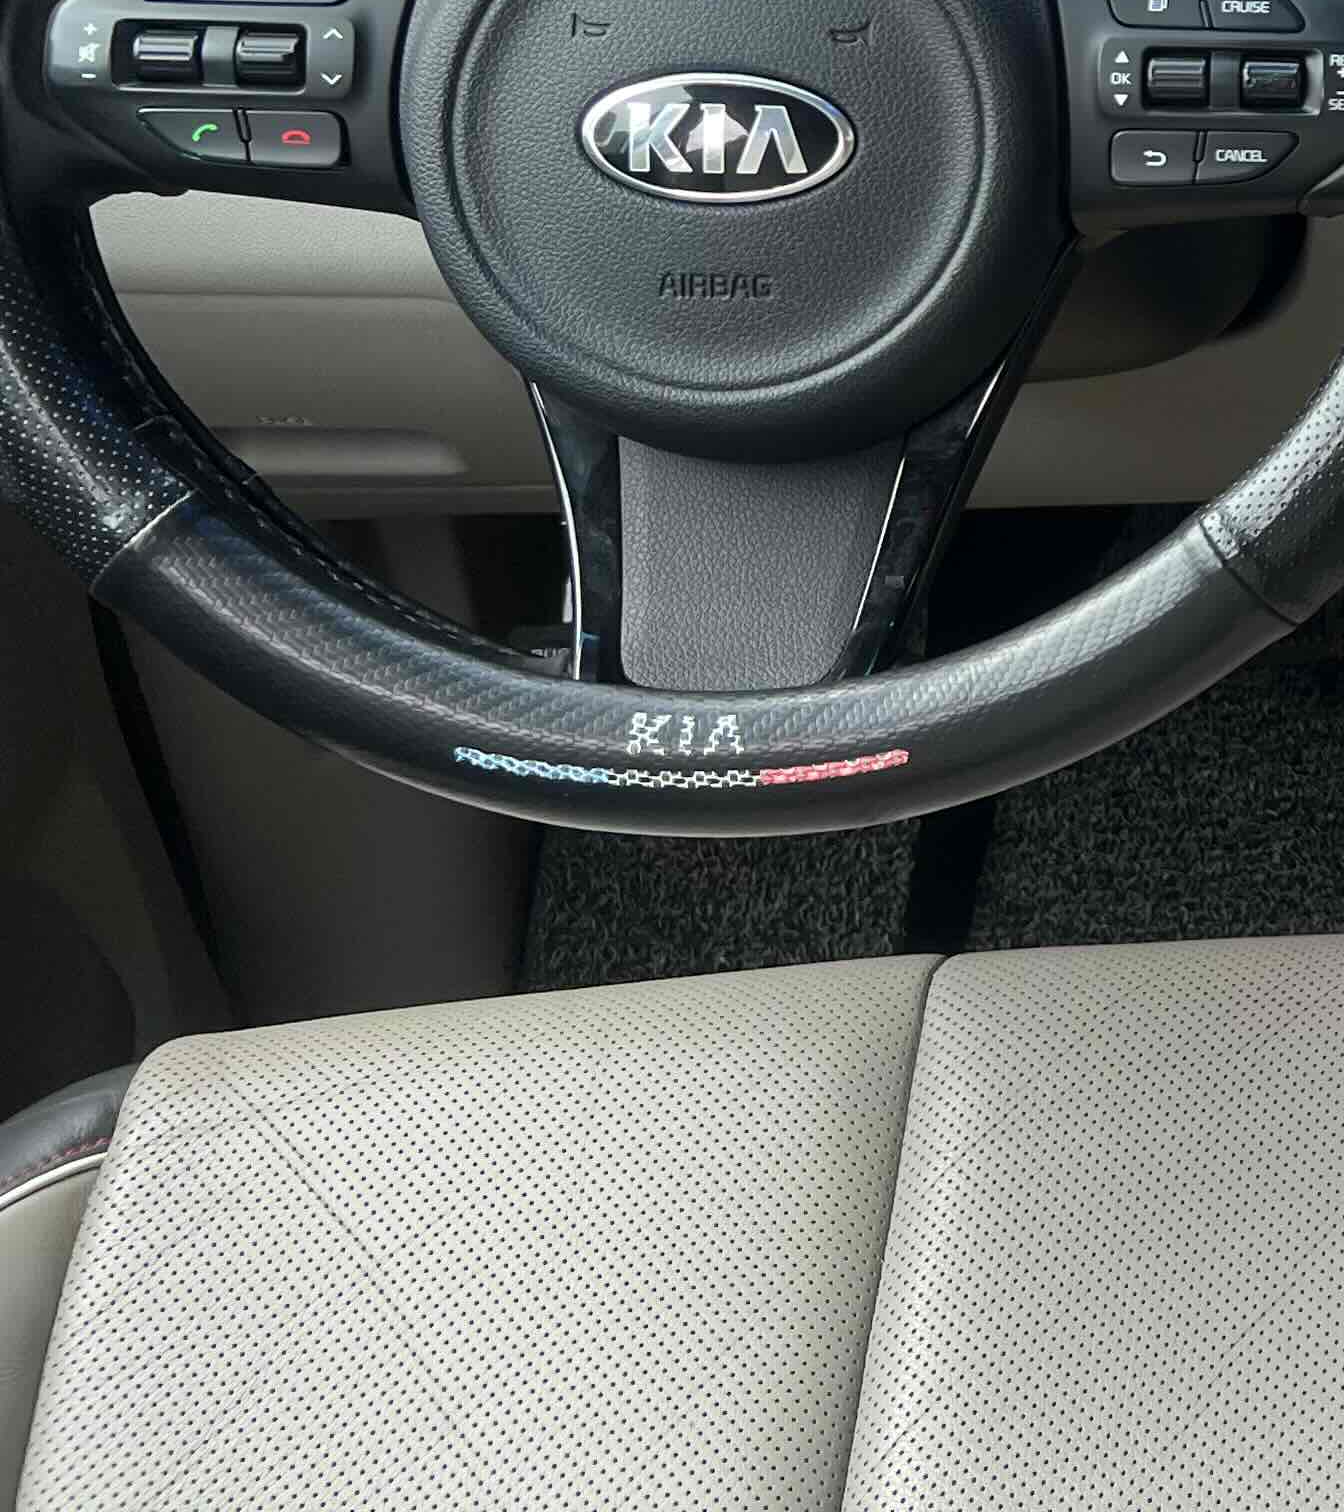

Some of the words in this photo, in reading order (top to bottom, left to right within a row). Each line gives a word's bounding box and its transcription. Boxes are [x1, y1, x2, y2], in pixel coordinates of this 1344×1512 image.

[1221, 0, 1273, 14] CRUISE
[1110, 73, 1132, 86] OK
[627, 103, 808, 174] KIA
[1215, 149, 1268, 163] CANCEL
[658, 273, 776, 299] AIRBAG
